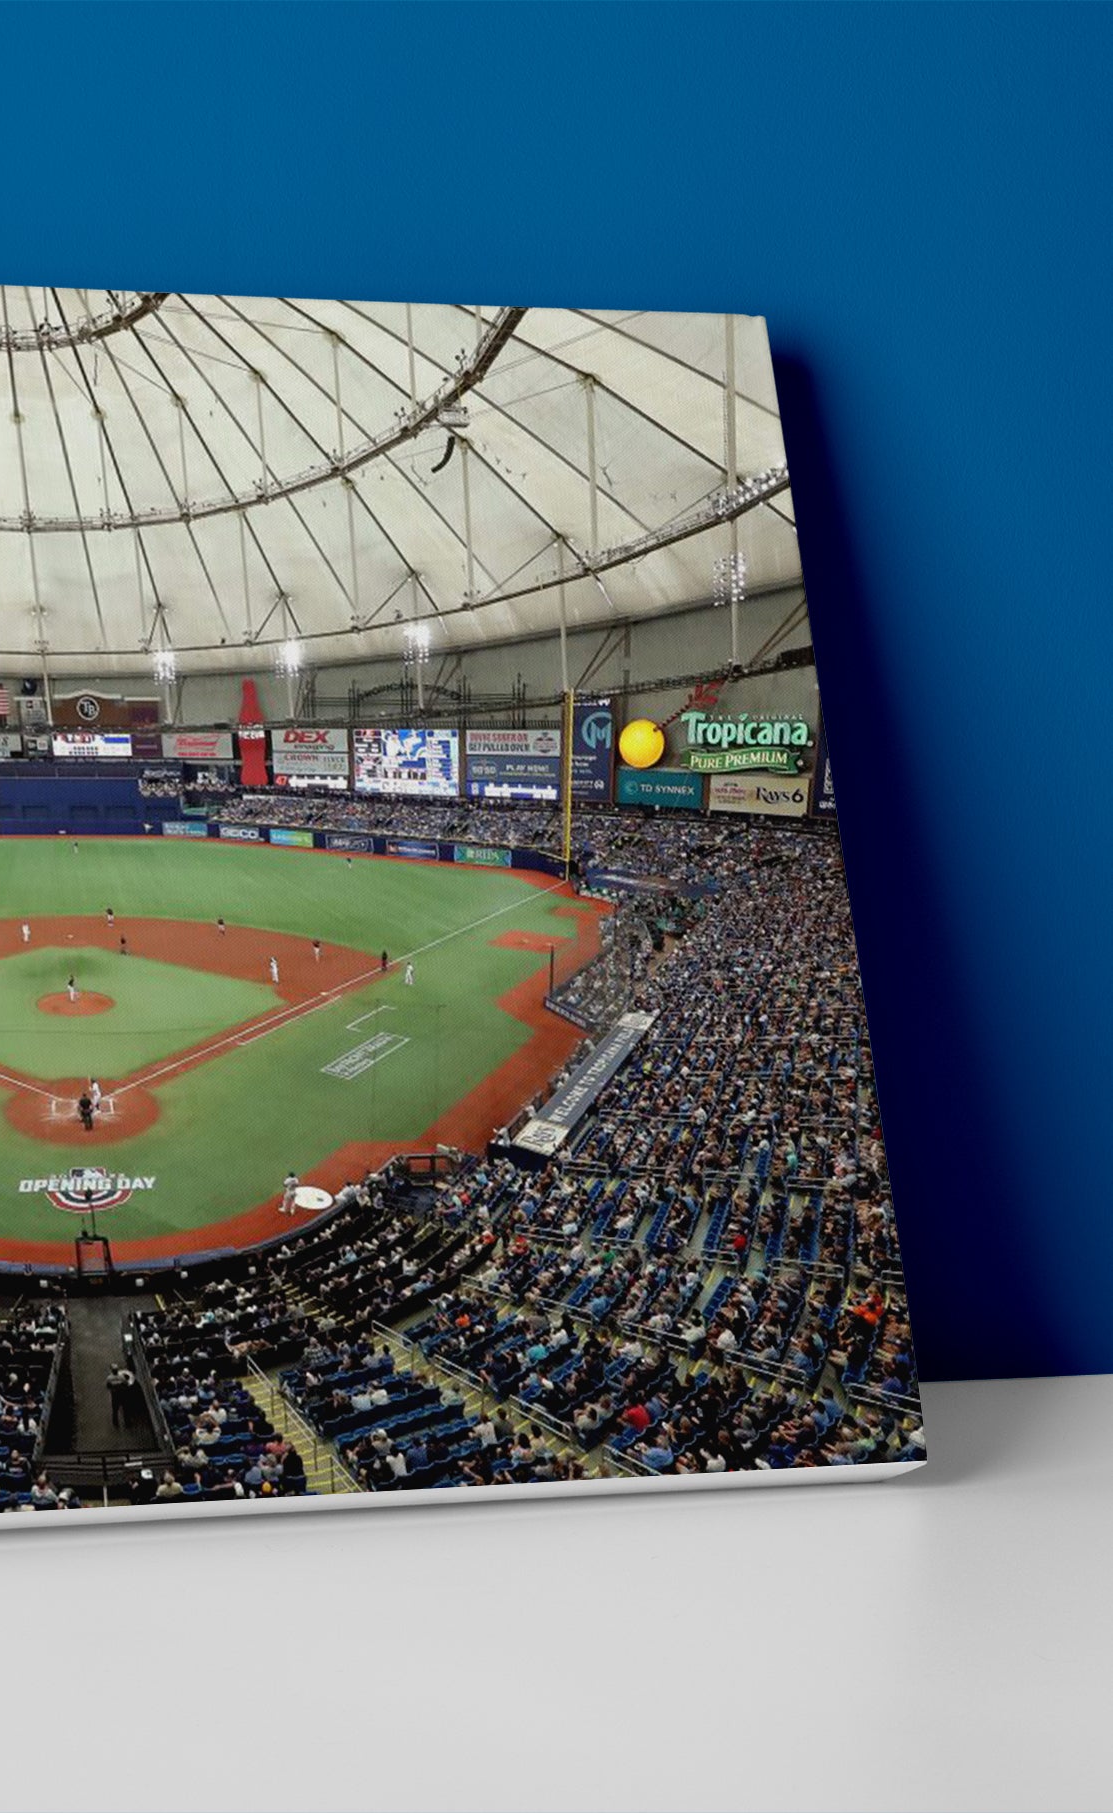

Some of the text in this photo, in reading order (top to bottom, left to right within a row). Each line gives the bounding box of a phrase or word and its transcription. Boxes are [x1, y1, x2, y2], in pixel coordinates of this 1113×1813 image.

[82, 701, 96, 716] TB
[283, 729, 330, 744] DEX
[681, 711, 809, 749] Tropicana
[690, 752, 787, 769] PURE PREMIUM
[639, 783, 695, 795] TD SYNNEX
[791, 788, 804, 803] 6
[221, 828, 259, 839] GEICO
[548, 1086, 589, 1122] WELCOME
[19, 1177, 112, 1192] OPENING
[117, 1176, 157, 1190] DAY
